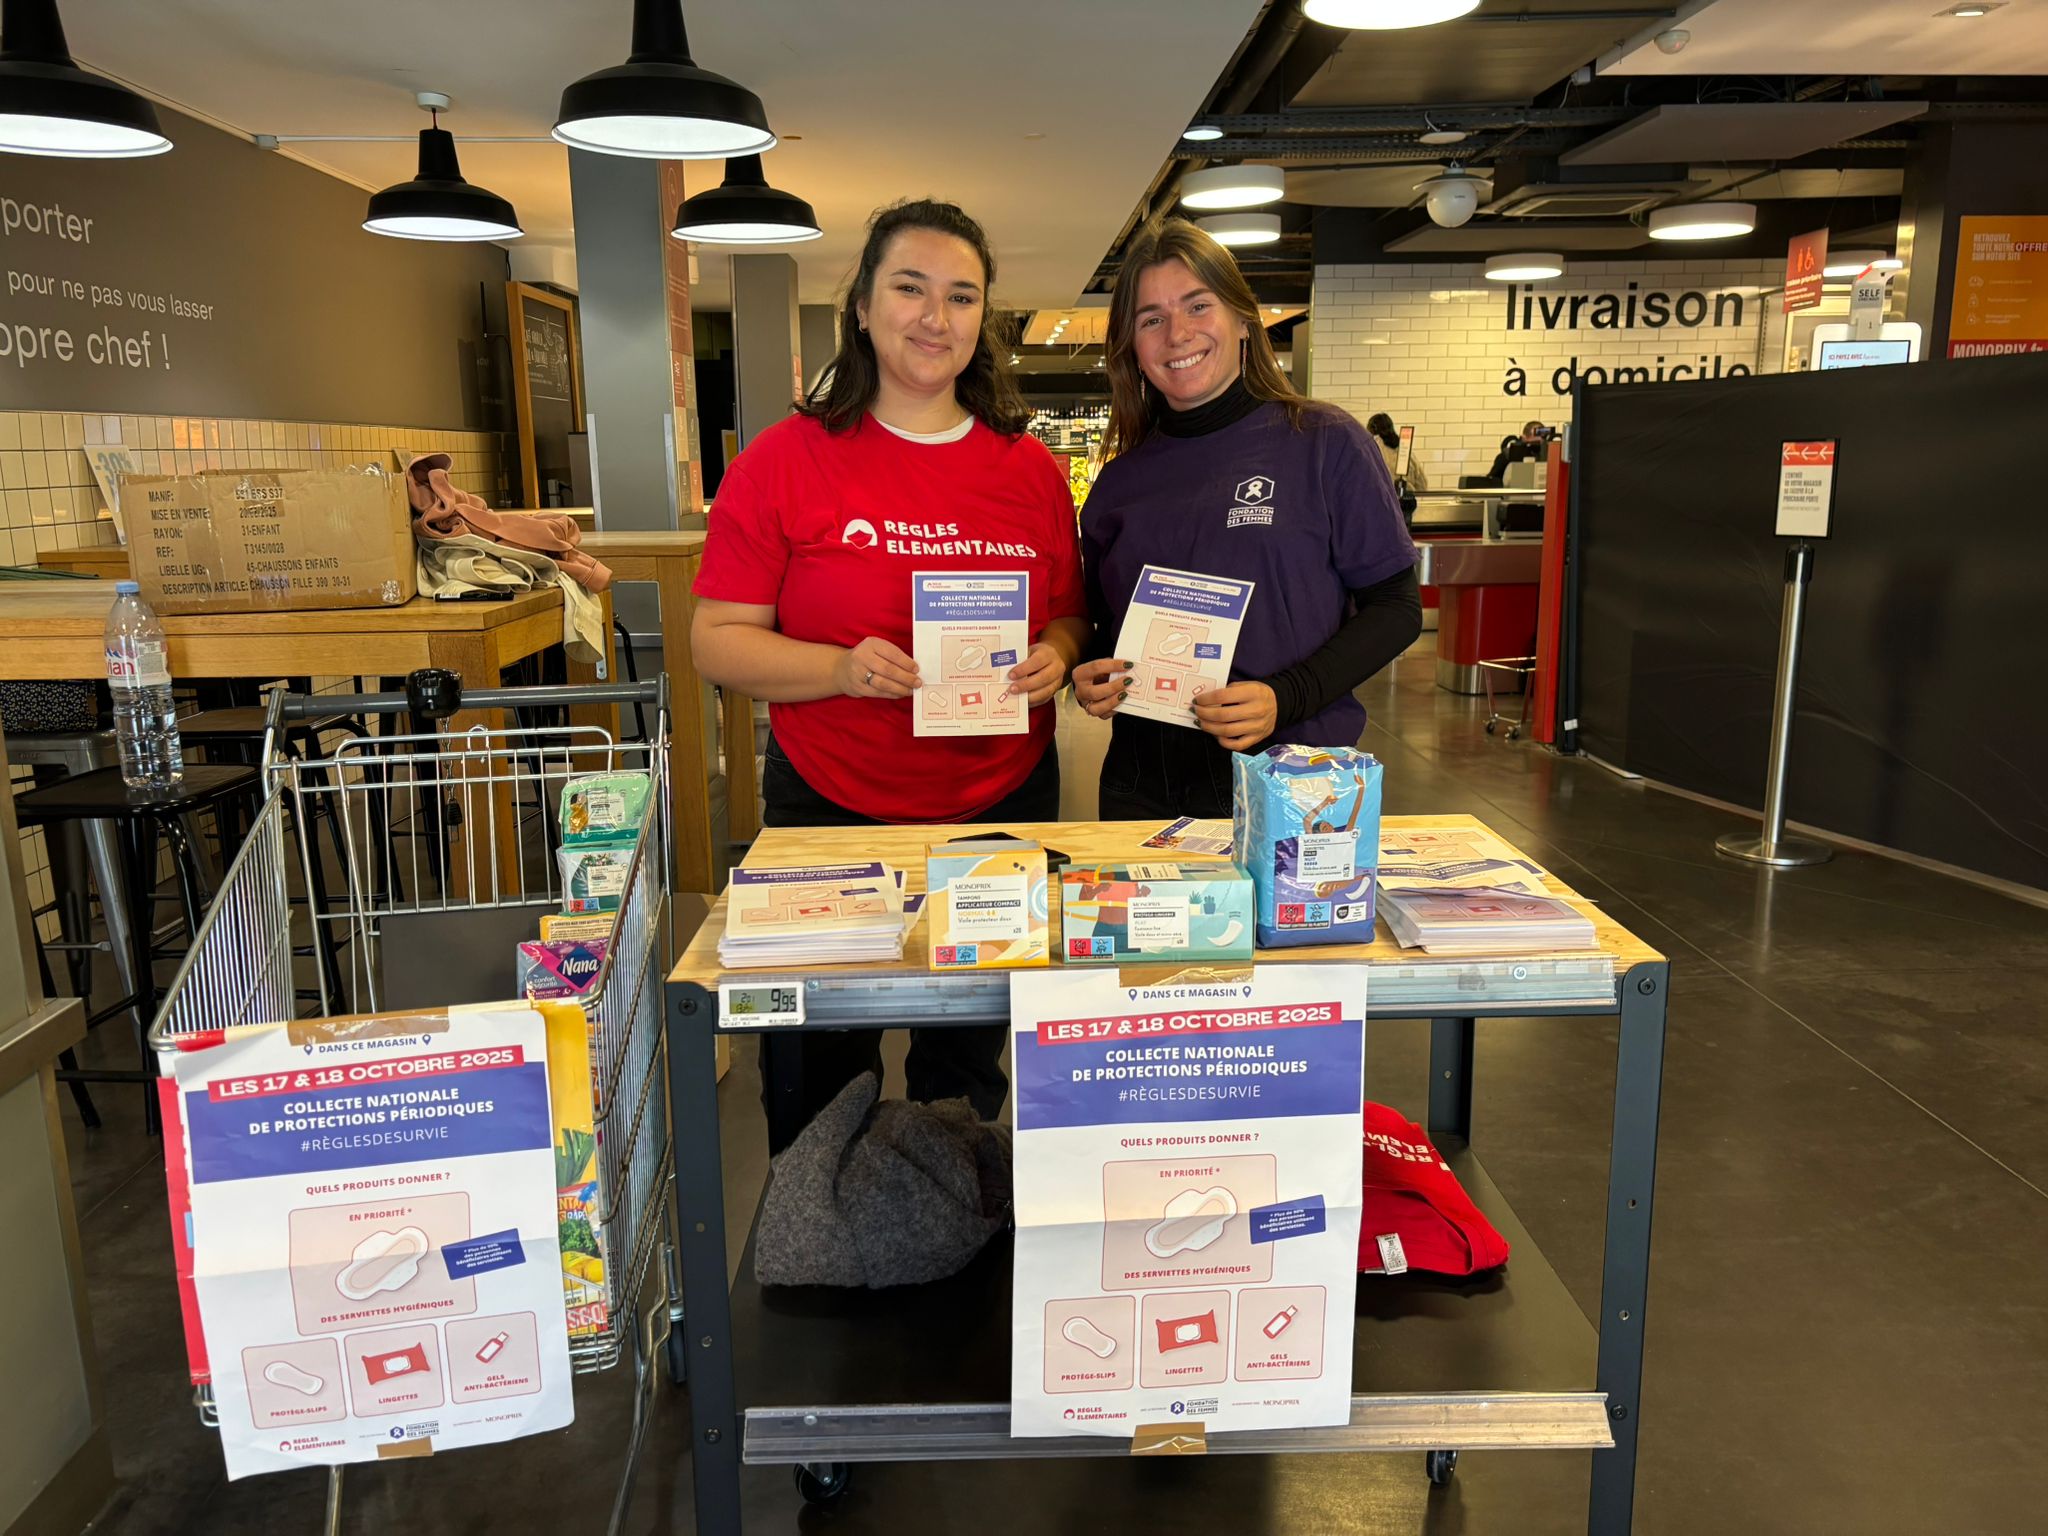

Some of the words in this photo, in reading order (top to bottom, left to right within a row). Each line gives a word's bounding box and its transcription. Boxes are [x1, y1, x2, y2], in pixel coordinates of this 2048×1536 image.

[7, 270, 54, 295] pour
[61, 279, 84, 300] ne
[91, 284, 123, 308] pas
[127, 291, 166, 313] vous
[170, 294, 214, 321] lasser
[1859, 289, 1880, 297] SELF
[1506, 282, 1744, 330] livraison
[87, 325, 151, 368] chef
[162, 333, 170, 370] !
[1503, 358, 1526, 396] à
[148, 490, 174, 503] MANIF:
[151, 508, 168, 521] MISE
[170, 508, 181, 520] EN
[183, 507, 211, 520] VENTE:
[1228, 508, 1274, 516] FONDATION
[153, 528, 183, 539] RAYON:
[241, 524, 281, 536] 31-ENFANT
[884, 520, 959, 539] REGLES
[156, 546, 174, 558] REF:
[886, 540, 1037, 558] ELEMENTAIRES
[160, 564, 190, 577] LIBELLE
[305, 558, 339, 570] ENFANTS
[162, 581, 212, 595] DESCRIPTION
[214, 580, 249, 593] ARTICLE:
[250, 578, 291, 591] CHAUSSON
[292, 576, 313, 589] FILLE
[107, 658, 134, 675] ian
[562, 958, 599, 976] Nana
[1143, 990, 1172, 999] DANS
[1174, 989, 1186, 998] CE
[1188, 987, 1237, 998] MAGASIN
[1047, 1023, 1083, 1040] LES
[1089, 1022, 1111, 1037] 17
[1117, 1020, 1133, 1034] &
[1138, 1018, 1164, 1033] 18
[1169, 1011, 1274, 1029] OCTOBRE
[1278, 1007, 1332, 1023] 2025
[319, 1043, 349, 1053] DANS
[351, 1041, 364, 1051] CE
[366, 1037, 418, 1050] MAGASIN
[1105, 1049, 1180, 1063] COLLECTE
[1184, 1045, 1275, 1060] NATIONALE
[219, 1079, 260, 1098] LES
[263, 1076, 289, 1094] 17
[294, 1072, 310, 1088] &
[315, 1070, 343, 1086] 18
[349, 1057, 456, 1081] OCTOBRE
[459, 1050, 514, 1067] 2025
[1072, 1070, 1091, 1082] DE
[1095, 1064, 1202, 1080] PROTECTIONS
[1206, 1058, 1308, 1077] PÉRIODIQUES
[1118, 1085, 1261, 1102] #RÈGLESDESURVIE
[283, 1097, 363, 1116] COLLECTE
[366, 1088, 460, 1108] NATIONALE
[249, 1121, 270, 1136] DE
[274, 1110, 386, 1133] PROTECTIONS
[389, 1099, 494, 1124] PÉRIODIQUES
[300, 1126, 449, 1153] #RÈGLESDESURVIE
[1120, 1137, 1153, 1148] QUELS
[1155, 1135, 1206, 1146] PRODUITS
[1208, 1133, 1252, 1144] DONNER
[1254, 1133, 1260, 1142] ?
[1363, 1131, 1429, 1154] ELEM
[1159, 1170, 1172, 1178] EN
[1174, 1167, 1214, 1177] PRIORITÉ
[306, 1183, 340, 1196] QUELS
[343, 1178, 395, 1191] PRODUITS
[398, 1173, 443, 1186] DONNER
[445, 1172, 450, 1181] ?
[349, 1214, 361, 1222] EN
[364, 1207, 406, 1220] PRIORITÉ
[1124, 1271, 1141, 1279] DES
[1142, 1268, 1191, 1278] SERVIETTES
[1192, 1265, 1251, 1275] HYGIÉNIQUES
[320, 1316, 338, 1324] DES
[339, 1307, 391, 1321] SERVIETTES
[393, 1299, 454, 1315] HYGIÉNIQUES
[1247, 1358, 1311, 1369] ANTI-BACTÉRIENS
[1270, 1353, 1288, 1361] GELS
[486, 1373, 505, 1382] GELS
[1061, 1371, 1117, 1381] PROTÈGE-SLIPS
[1164, 1366, 1204, 1375] LINGETTES
[464, 1376, 529, 1392] ANTI-BACTÉRIENS
[378, 1392, 418, 1405] LINGETTES
[270, 1405, 328, 1417] PROTÈGE-SLIPS
[485, 1412, 523, 1423] MONOPRIX
[1077, 1411, 1127, 1421] ELEMENTAIRES
[405, 1422, 439, 1431] FONDATION
[293, 1436, 319, 1445] REGLES
[294, 1439, 346, 1451] ELEMENTAIRES
